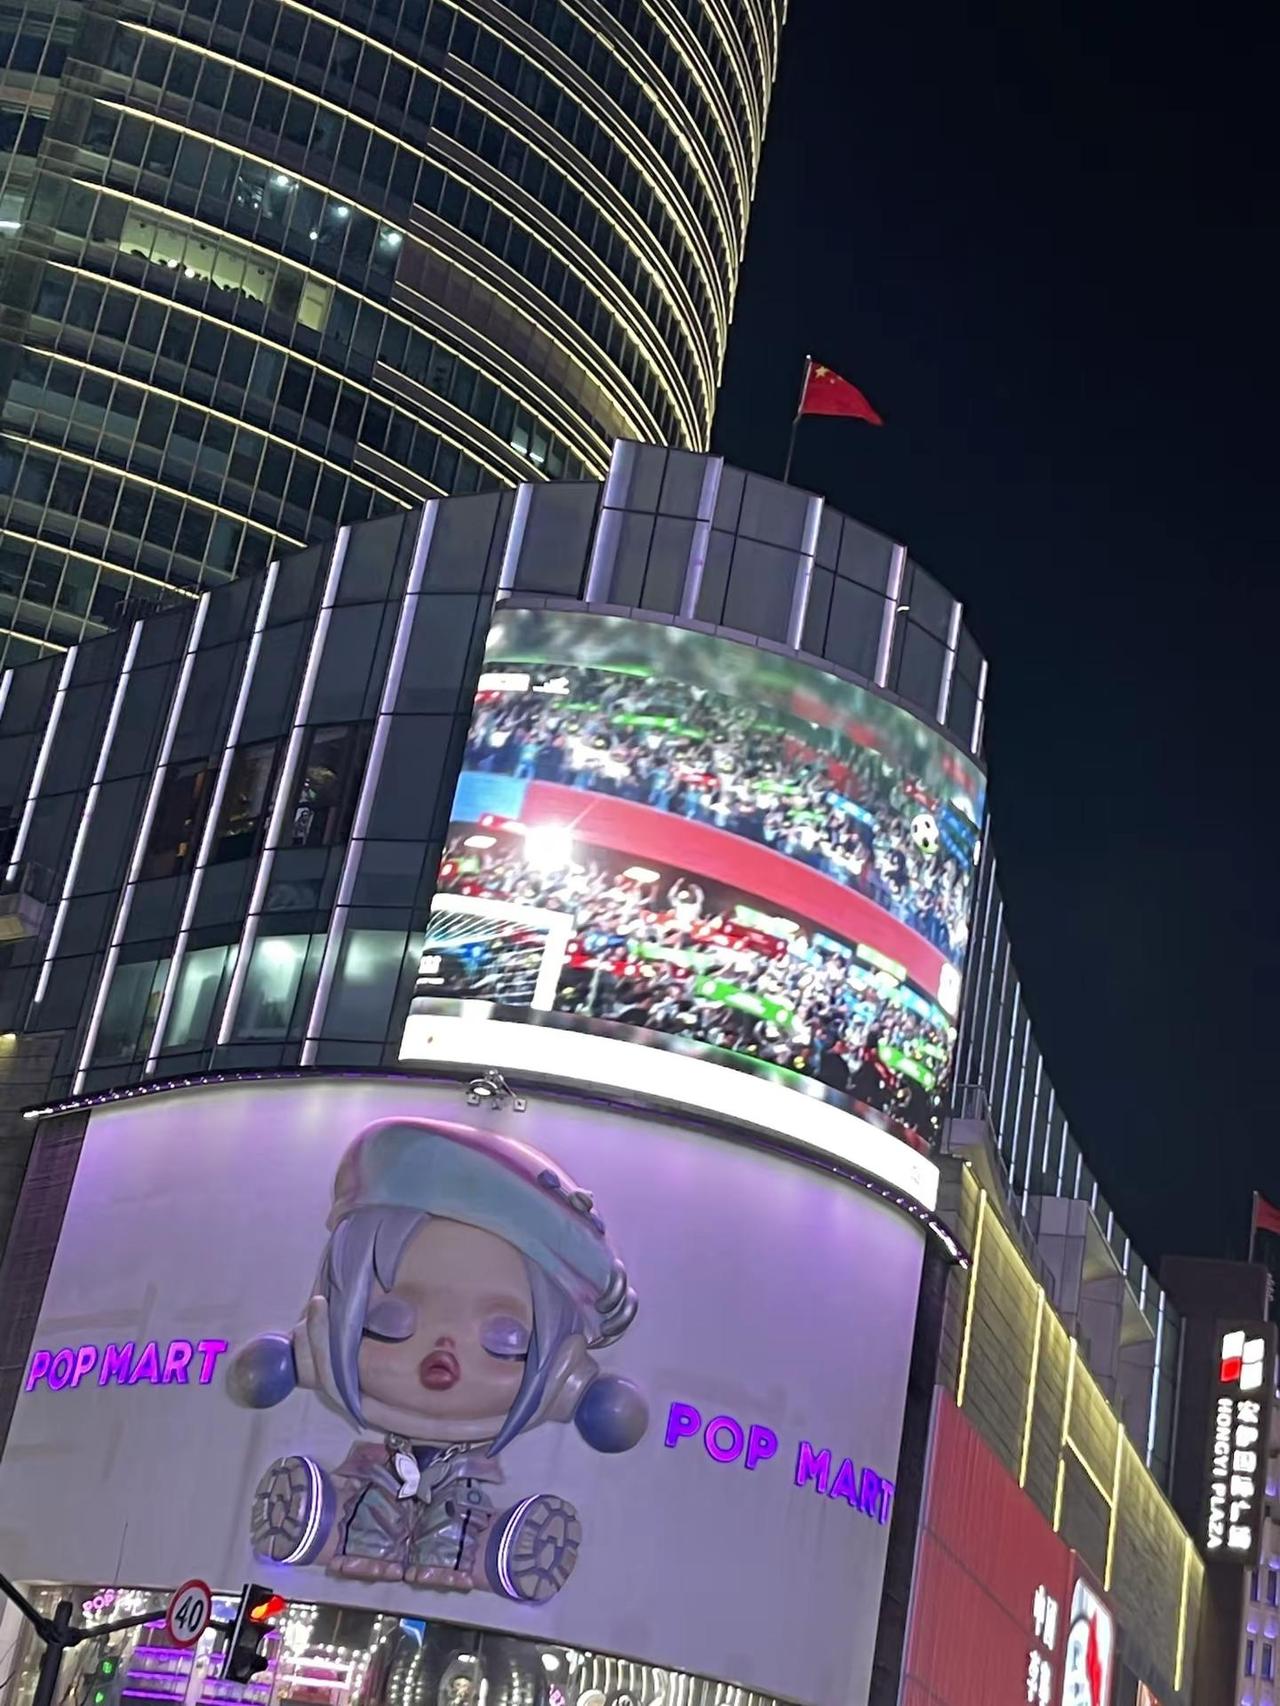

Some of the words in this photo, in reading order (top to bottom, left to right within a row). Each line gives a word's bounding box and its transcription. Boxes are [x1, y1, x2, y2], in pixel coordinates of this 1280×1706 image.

[664, 1401, 779, 1470] POP
[794, 1439, 894, 1526] MART
[1212, 1398, 1233, 1476] HONGYI
[1207, 1483, 1227, 1549] PLAZA
[175, 1596, 204, 1632] 40
